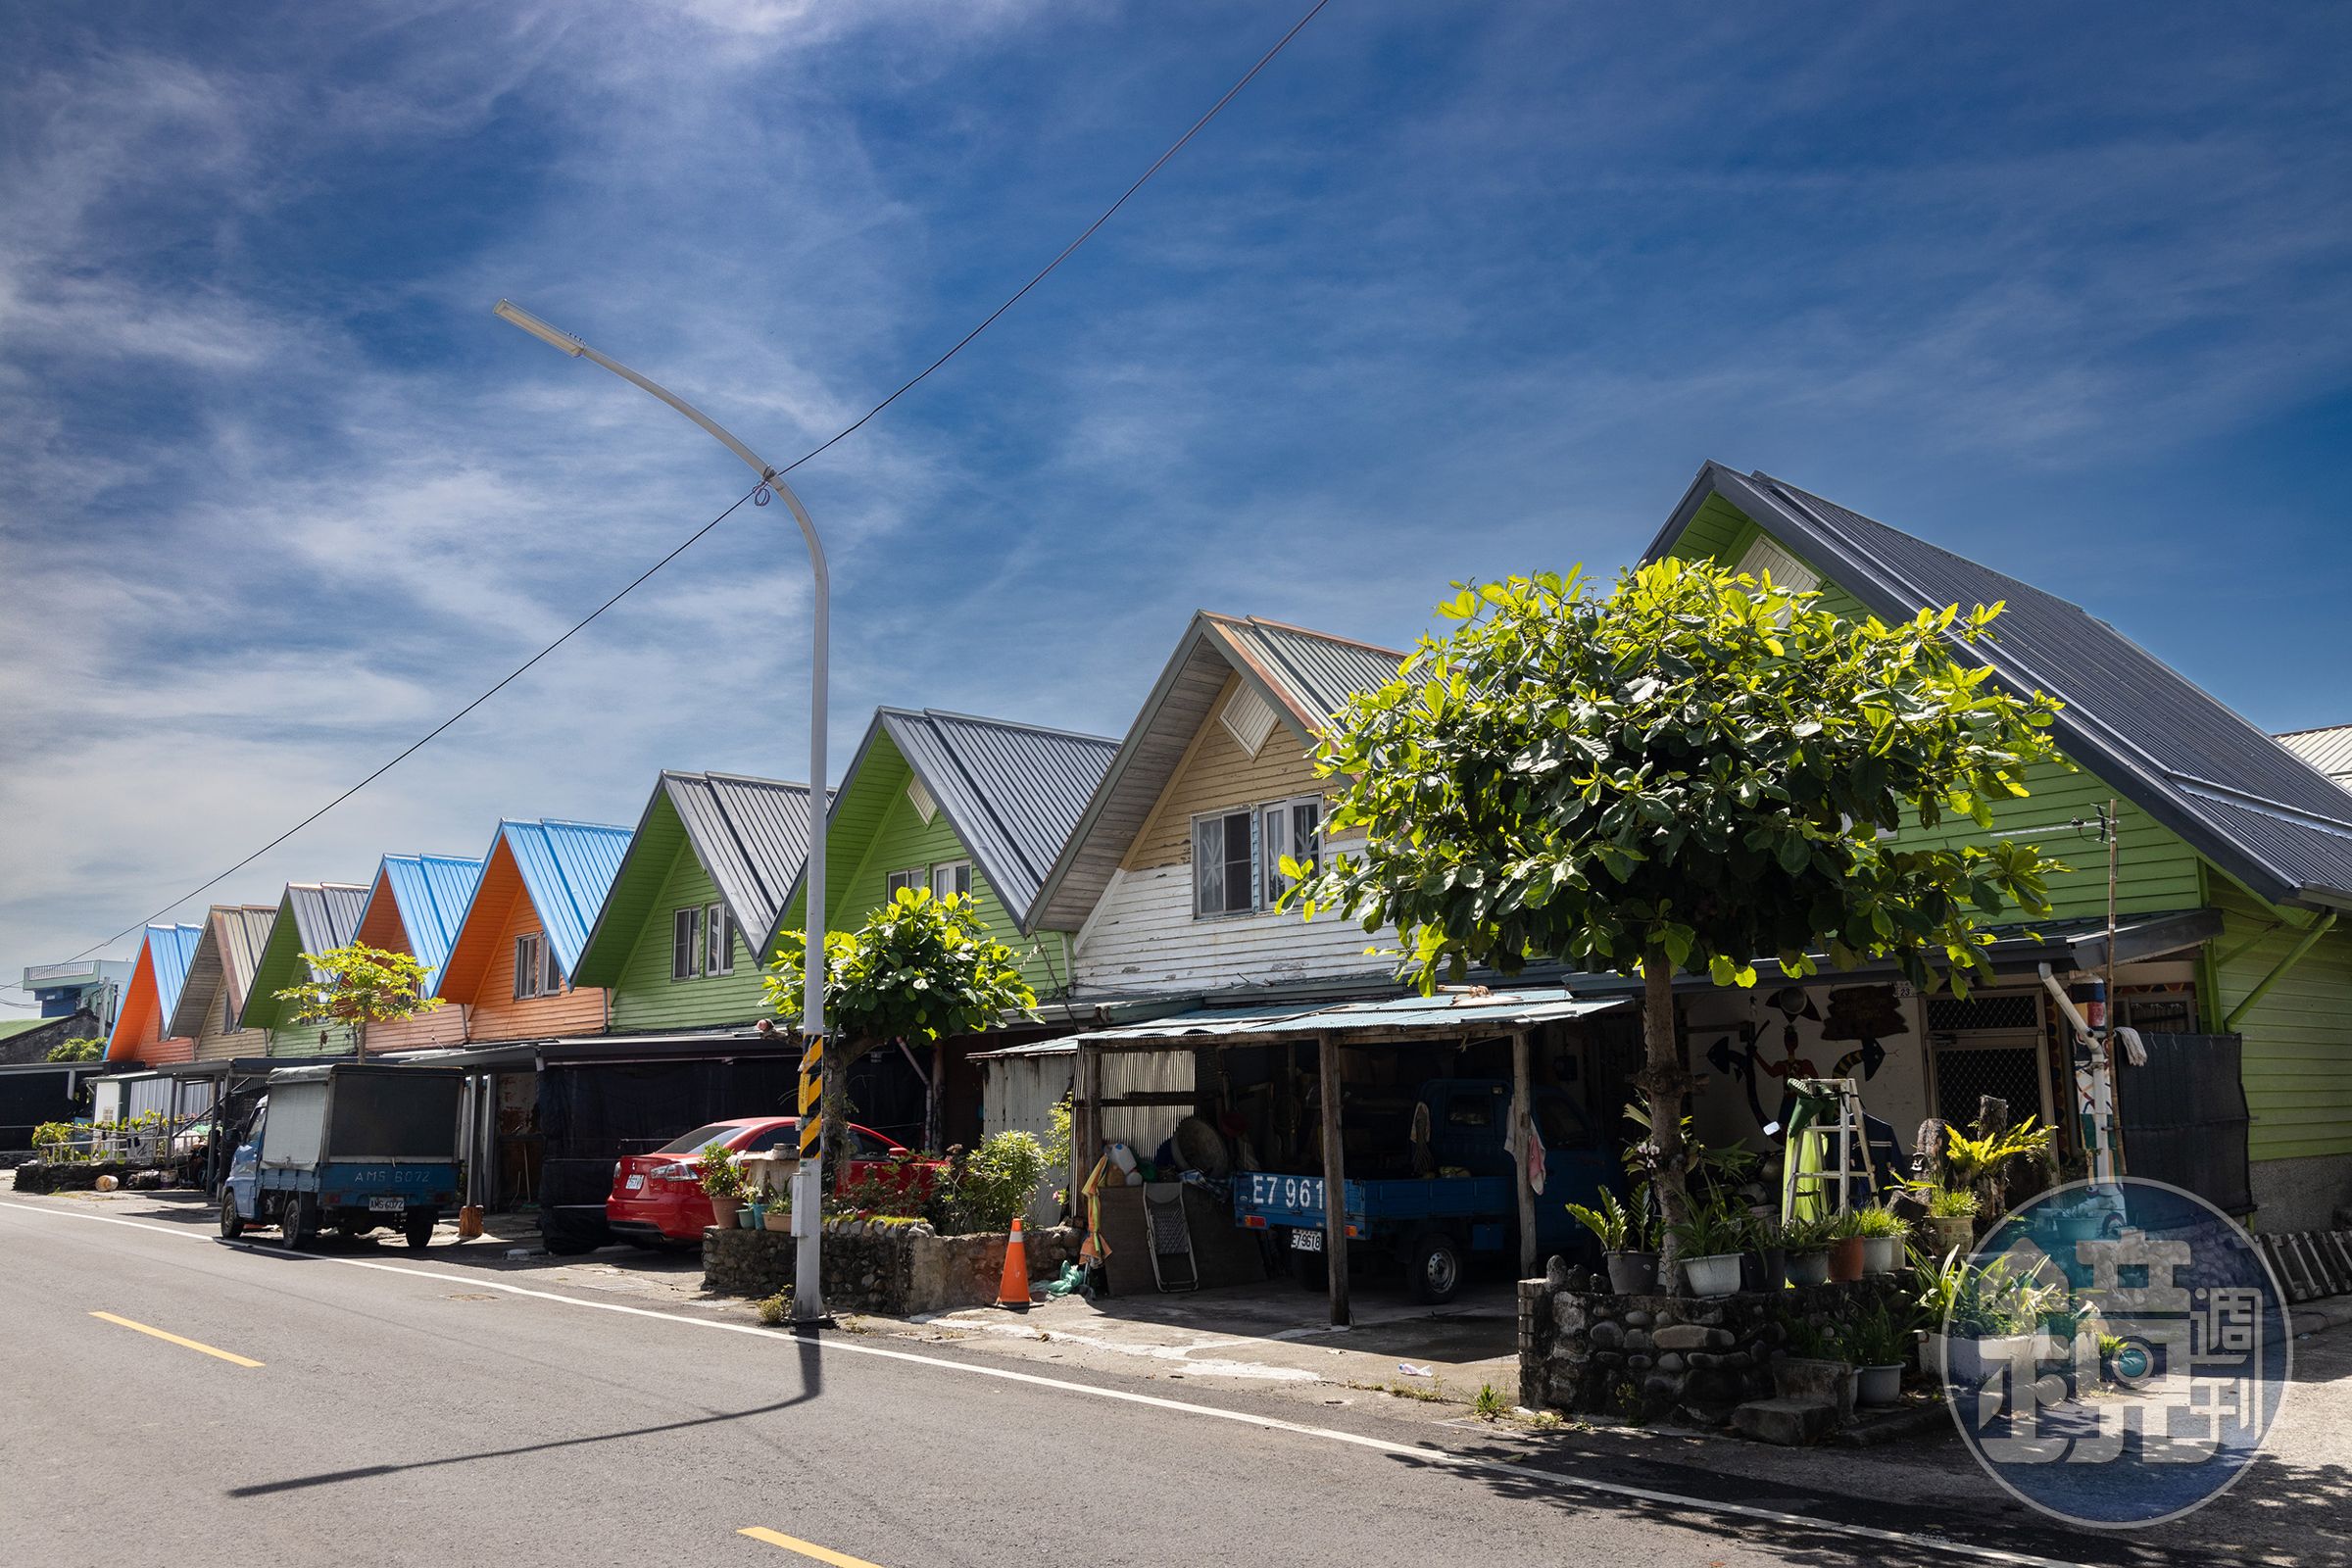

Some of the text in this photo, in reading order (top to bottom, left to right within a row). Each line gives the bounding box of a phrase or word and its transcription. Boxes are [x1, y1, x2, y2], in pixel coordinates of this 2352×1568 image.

[1900, 988, 1910, 997] 23
[355, 1171, 430, 1183] AMS 6072
[1252, 1175, 1323, 1209] E7 961
